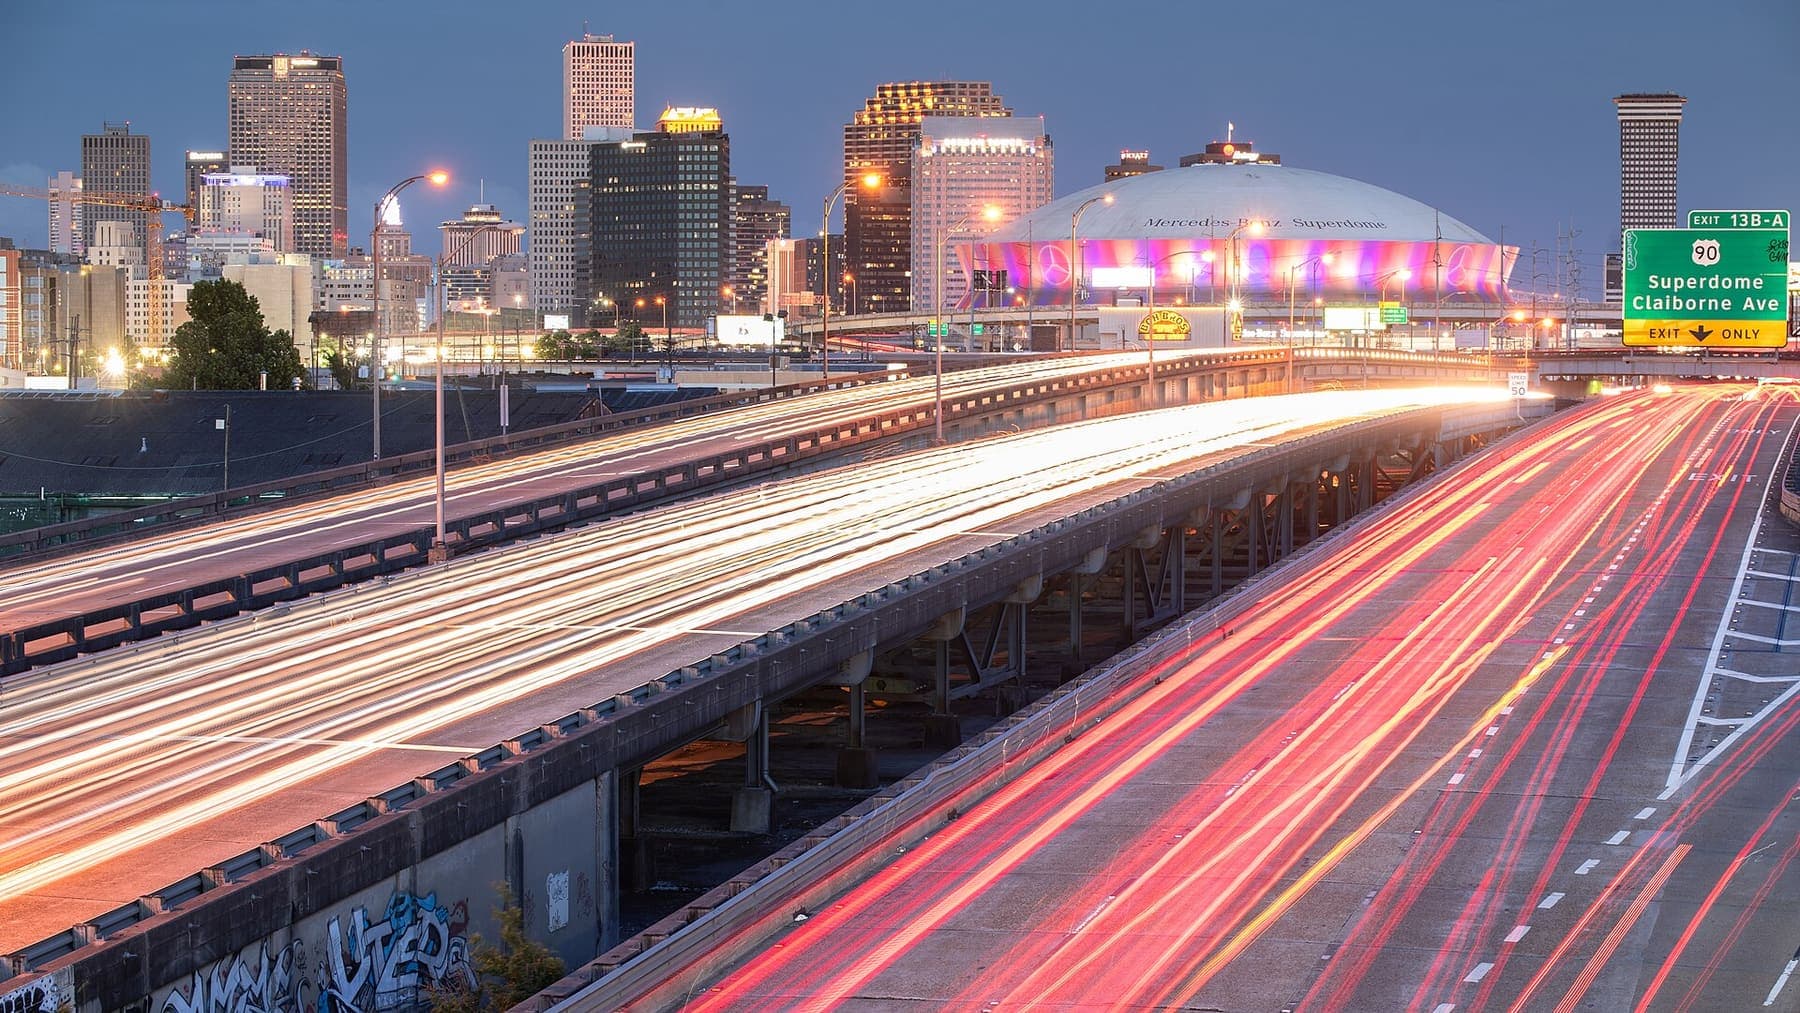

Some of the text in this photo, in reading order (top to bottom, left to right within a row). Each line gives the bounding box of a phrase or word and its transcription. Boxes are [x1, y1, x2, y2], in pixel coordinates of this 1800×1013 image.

[1144, 218, 1388, 230] Mercedes-Bnz Superdome
[1694, 214, 1784, 227] EXIT 13B-A
[1695, 246, 1718, 261] 90
[1648, 274, 1764, 293] Superdome
[1632, 295, 1780, 311] Claiborne Ave
[1649, 328, 1761, 339] EXIT ONLY
[1511, 386, 1526, 396] 50
[1688, 472, 1758, 483] EXIT
